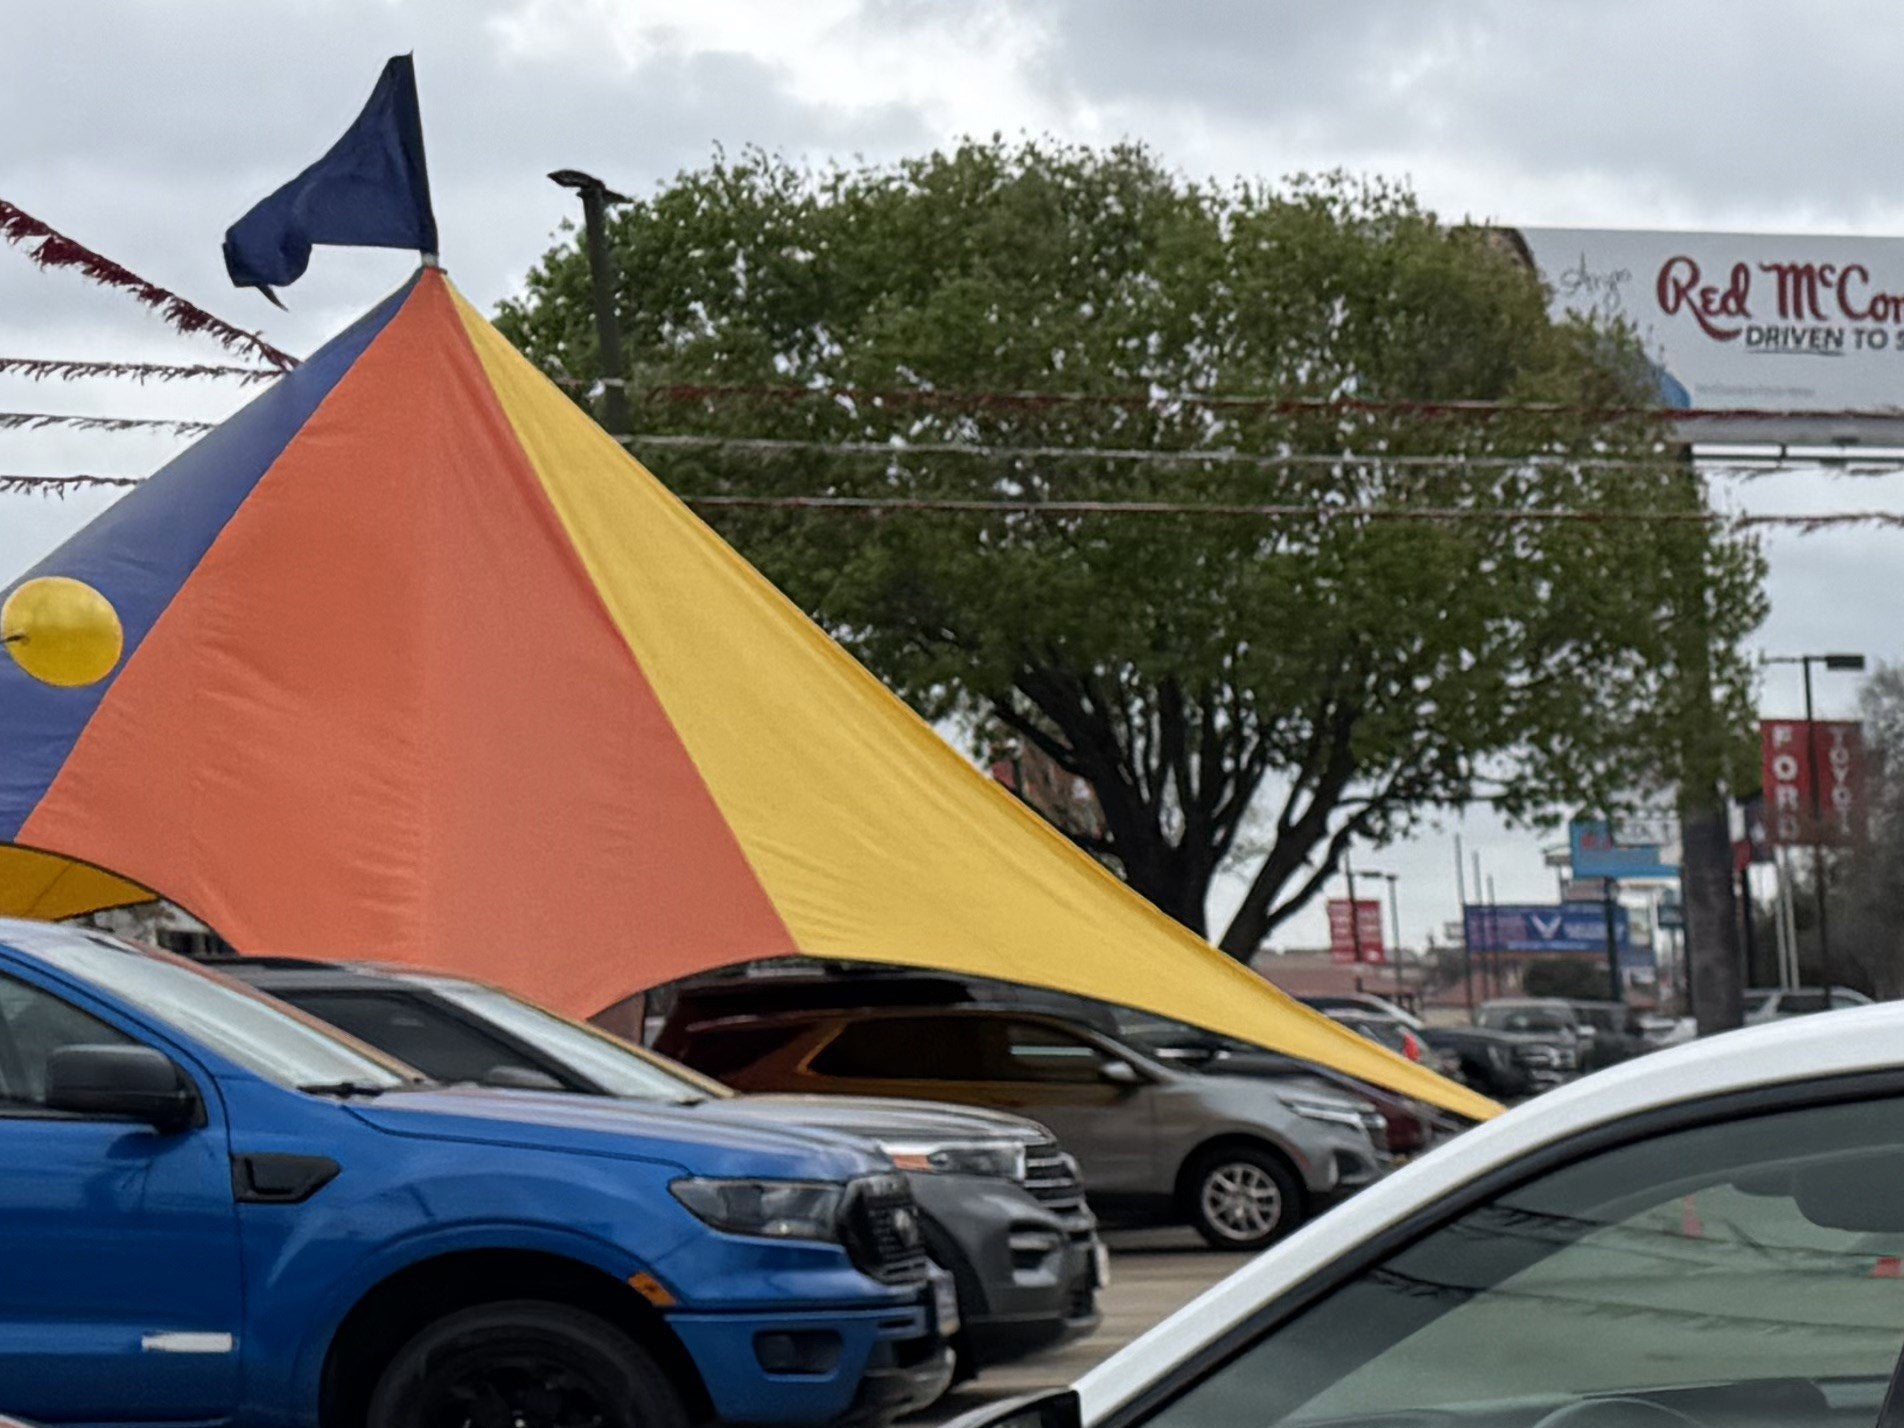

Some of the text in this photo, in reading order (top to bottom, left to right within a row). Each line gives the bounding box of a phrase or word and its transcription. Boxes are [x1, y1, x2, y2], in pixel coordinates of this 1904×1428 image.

[1655, 255, 1751, 342] Red
[1745, 325, 1844, 352] DRIVEN
[1853, 328, 1889, 350] TO
